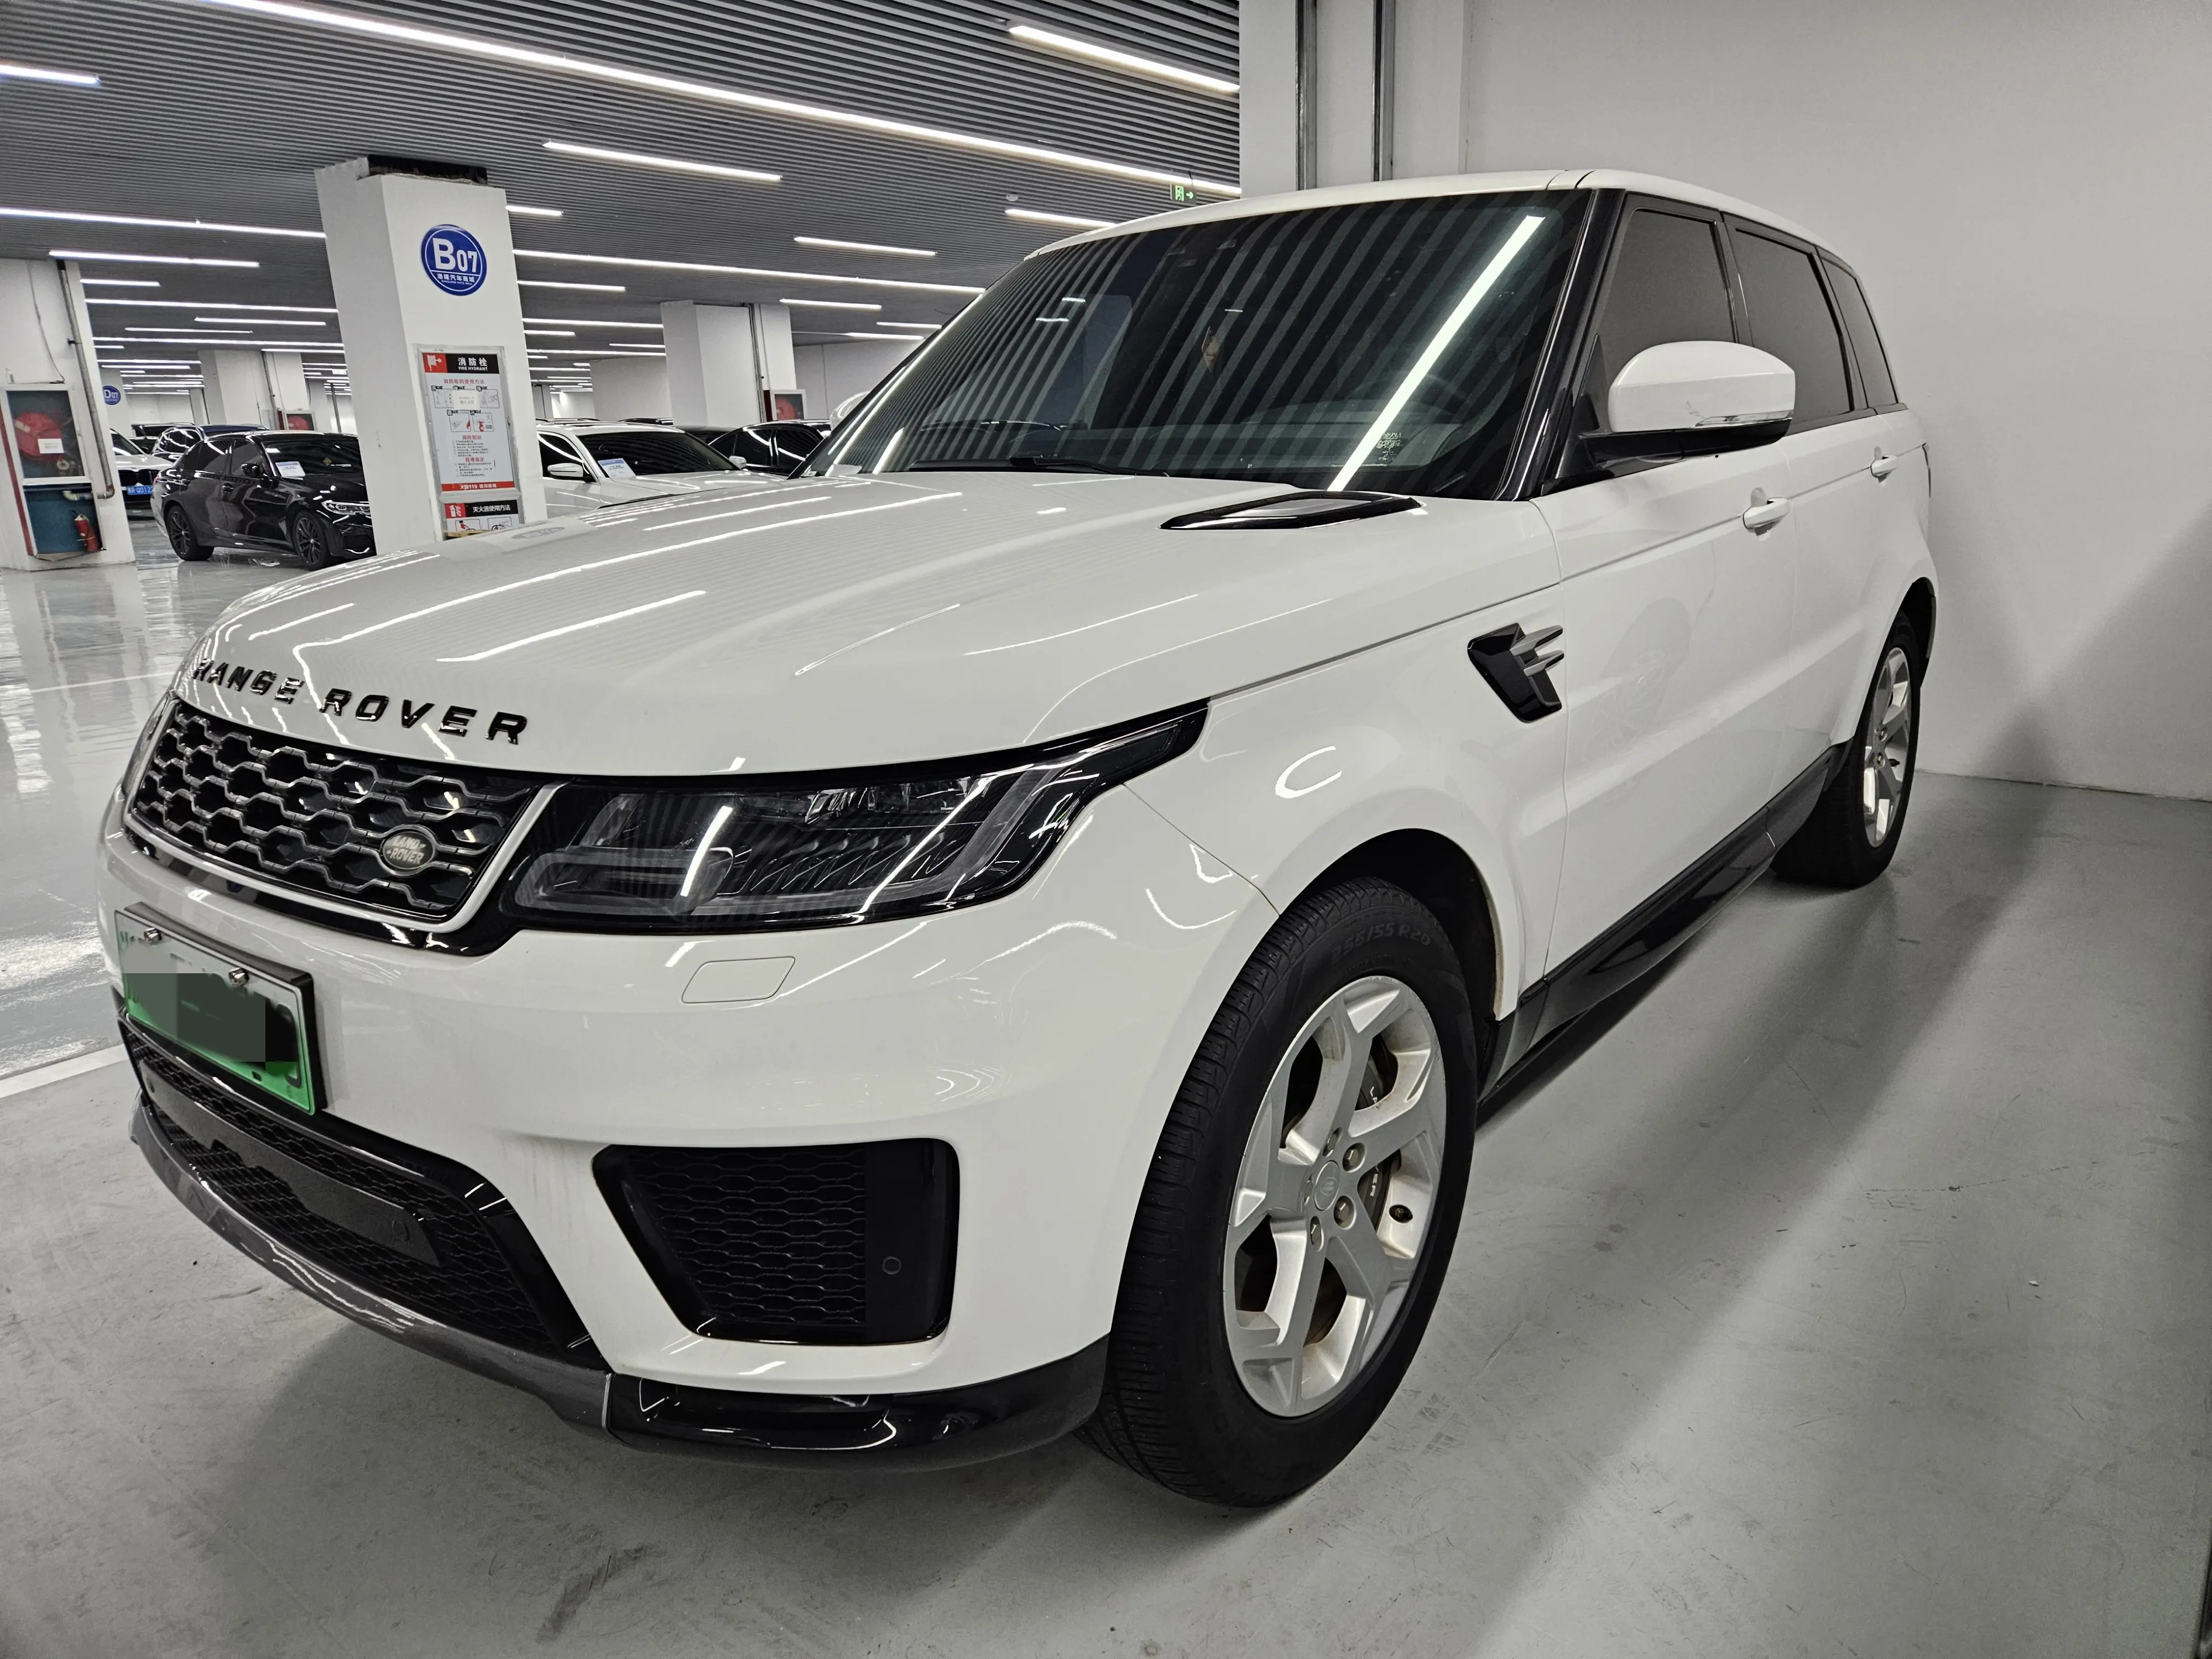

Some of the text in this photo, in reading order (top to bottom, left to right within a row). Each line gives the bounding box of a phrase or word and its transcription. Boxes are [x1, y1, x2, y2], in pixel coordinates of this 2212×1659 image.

[432, 237, 477, 273] B07
[458, 357, 488, 367] 消防栓
[103, 389, 118, 399] D07
[473, 504, 510, 513] 灭火器使用方法
[192, 658, 527, 745] RANGE ROVER
[392, 836, 421, 849] LAND
[389, 848, 425, 864] ROVER
